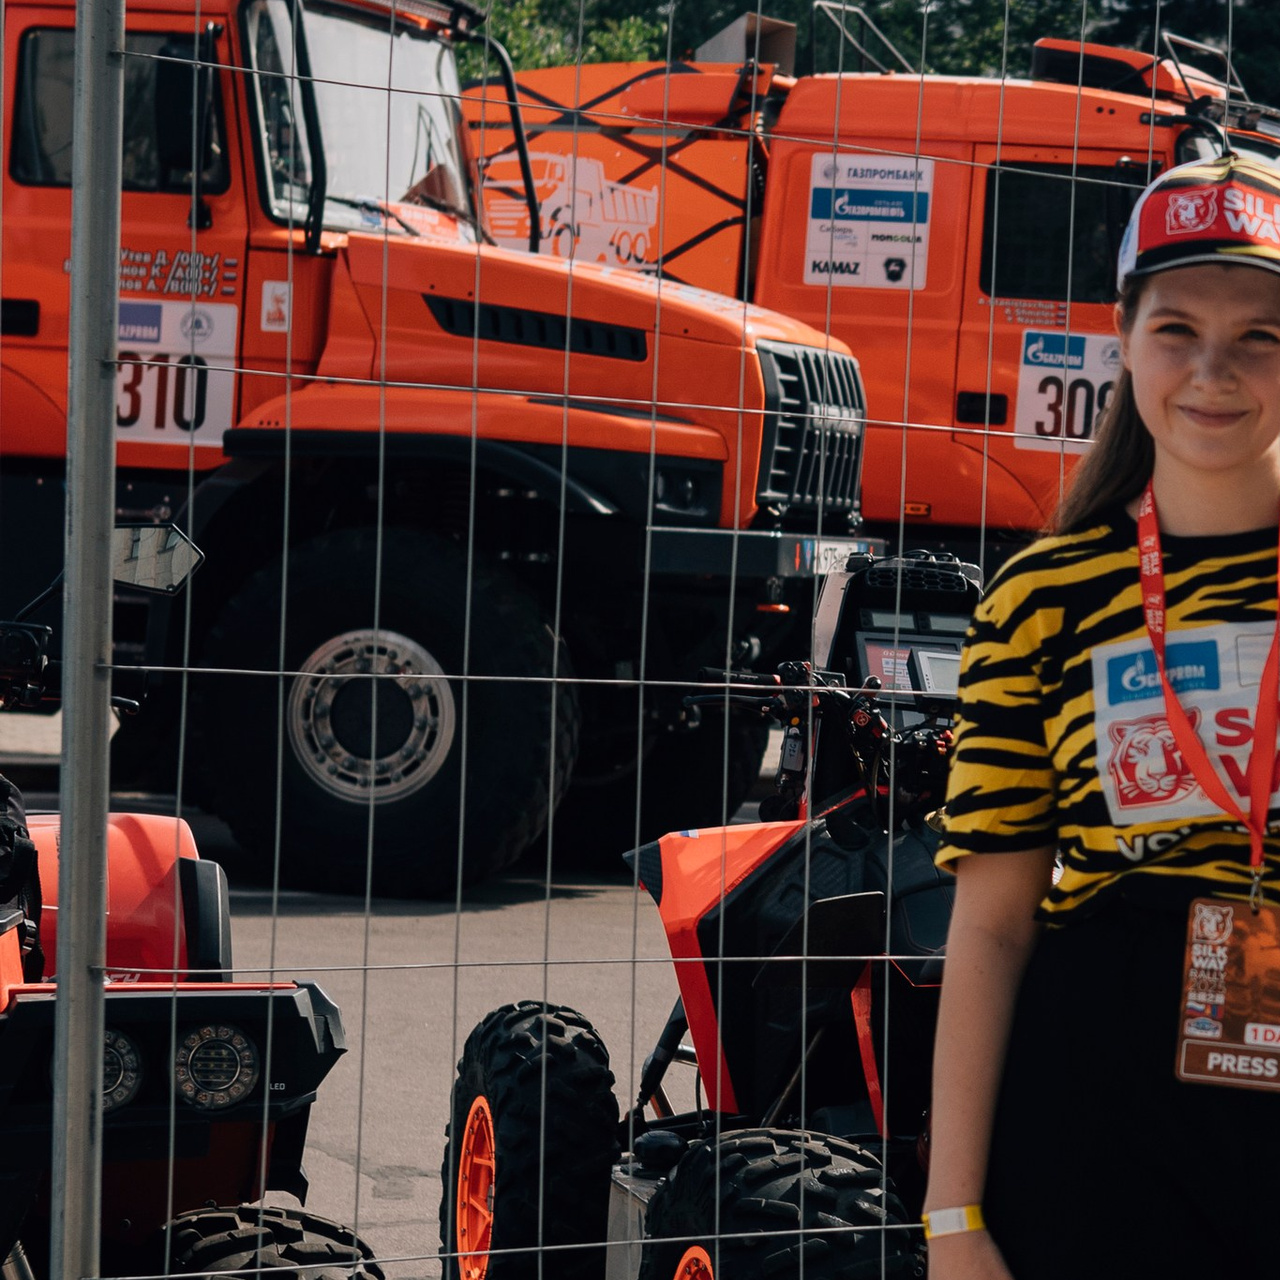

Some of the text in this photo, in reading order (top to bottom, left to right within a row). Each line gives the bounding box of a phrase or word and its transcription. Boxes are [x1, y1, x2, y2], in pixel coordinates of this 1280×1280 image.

[847, 167, 924, 181] ГАЗПРОМБАНК
[812, 260, 860, 275] KAMAZ
[118, 324, 159, 340] AZPROM
[116, 351, 208, 432] 310
[1192, 943, 1228, 958] SILK
[1192, 956, 1228, 971] WAY
[1189, 968, 1227, 982] RALLY
[1251, 1028, 1258, 1041] 1
[1207, 1051, 1279, 1078] PRESS
[269, 1082, 286, 1091] LED
